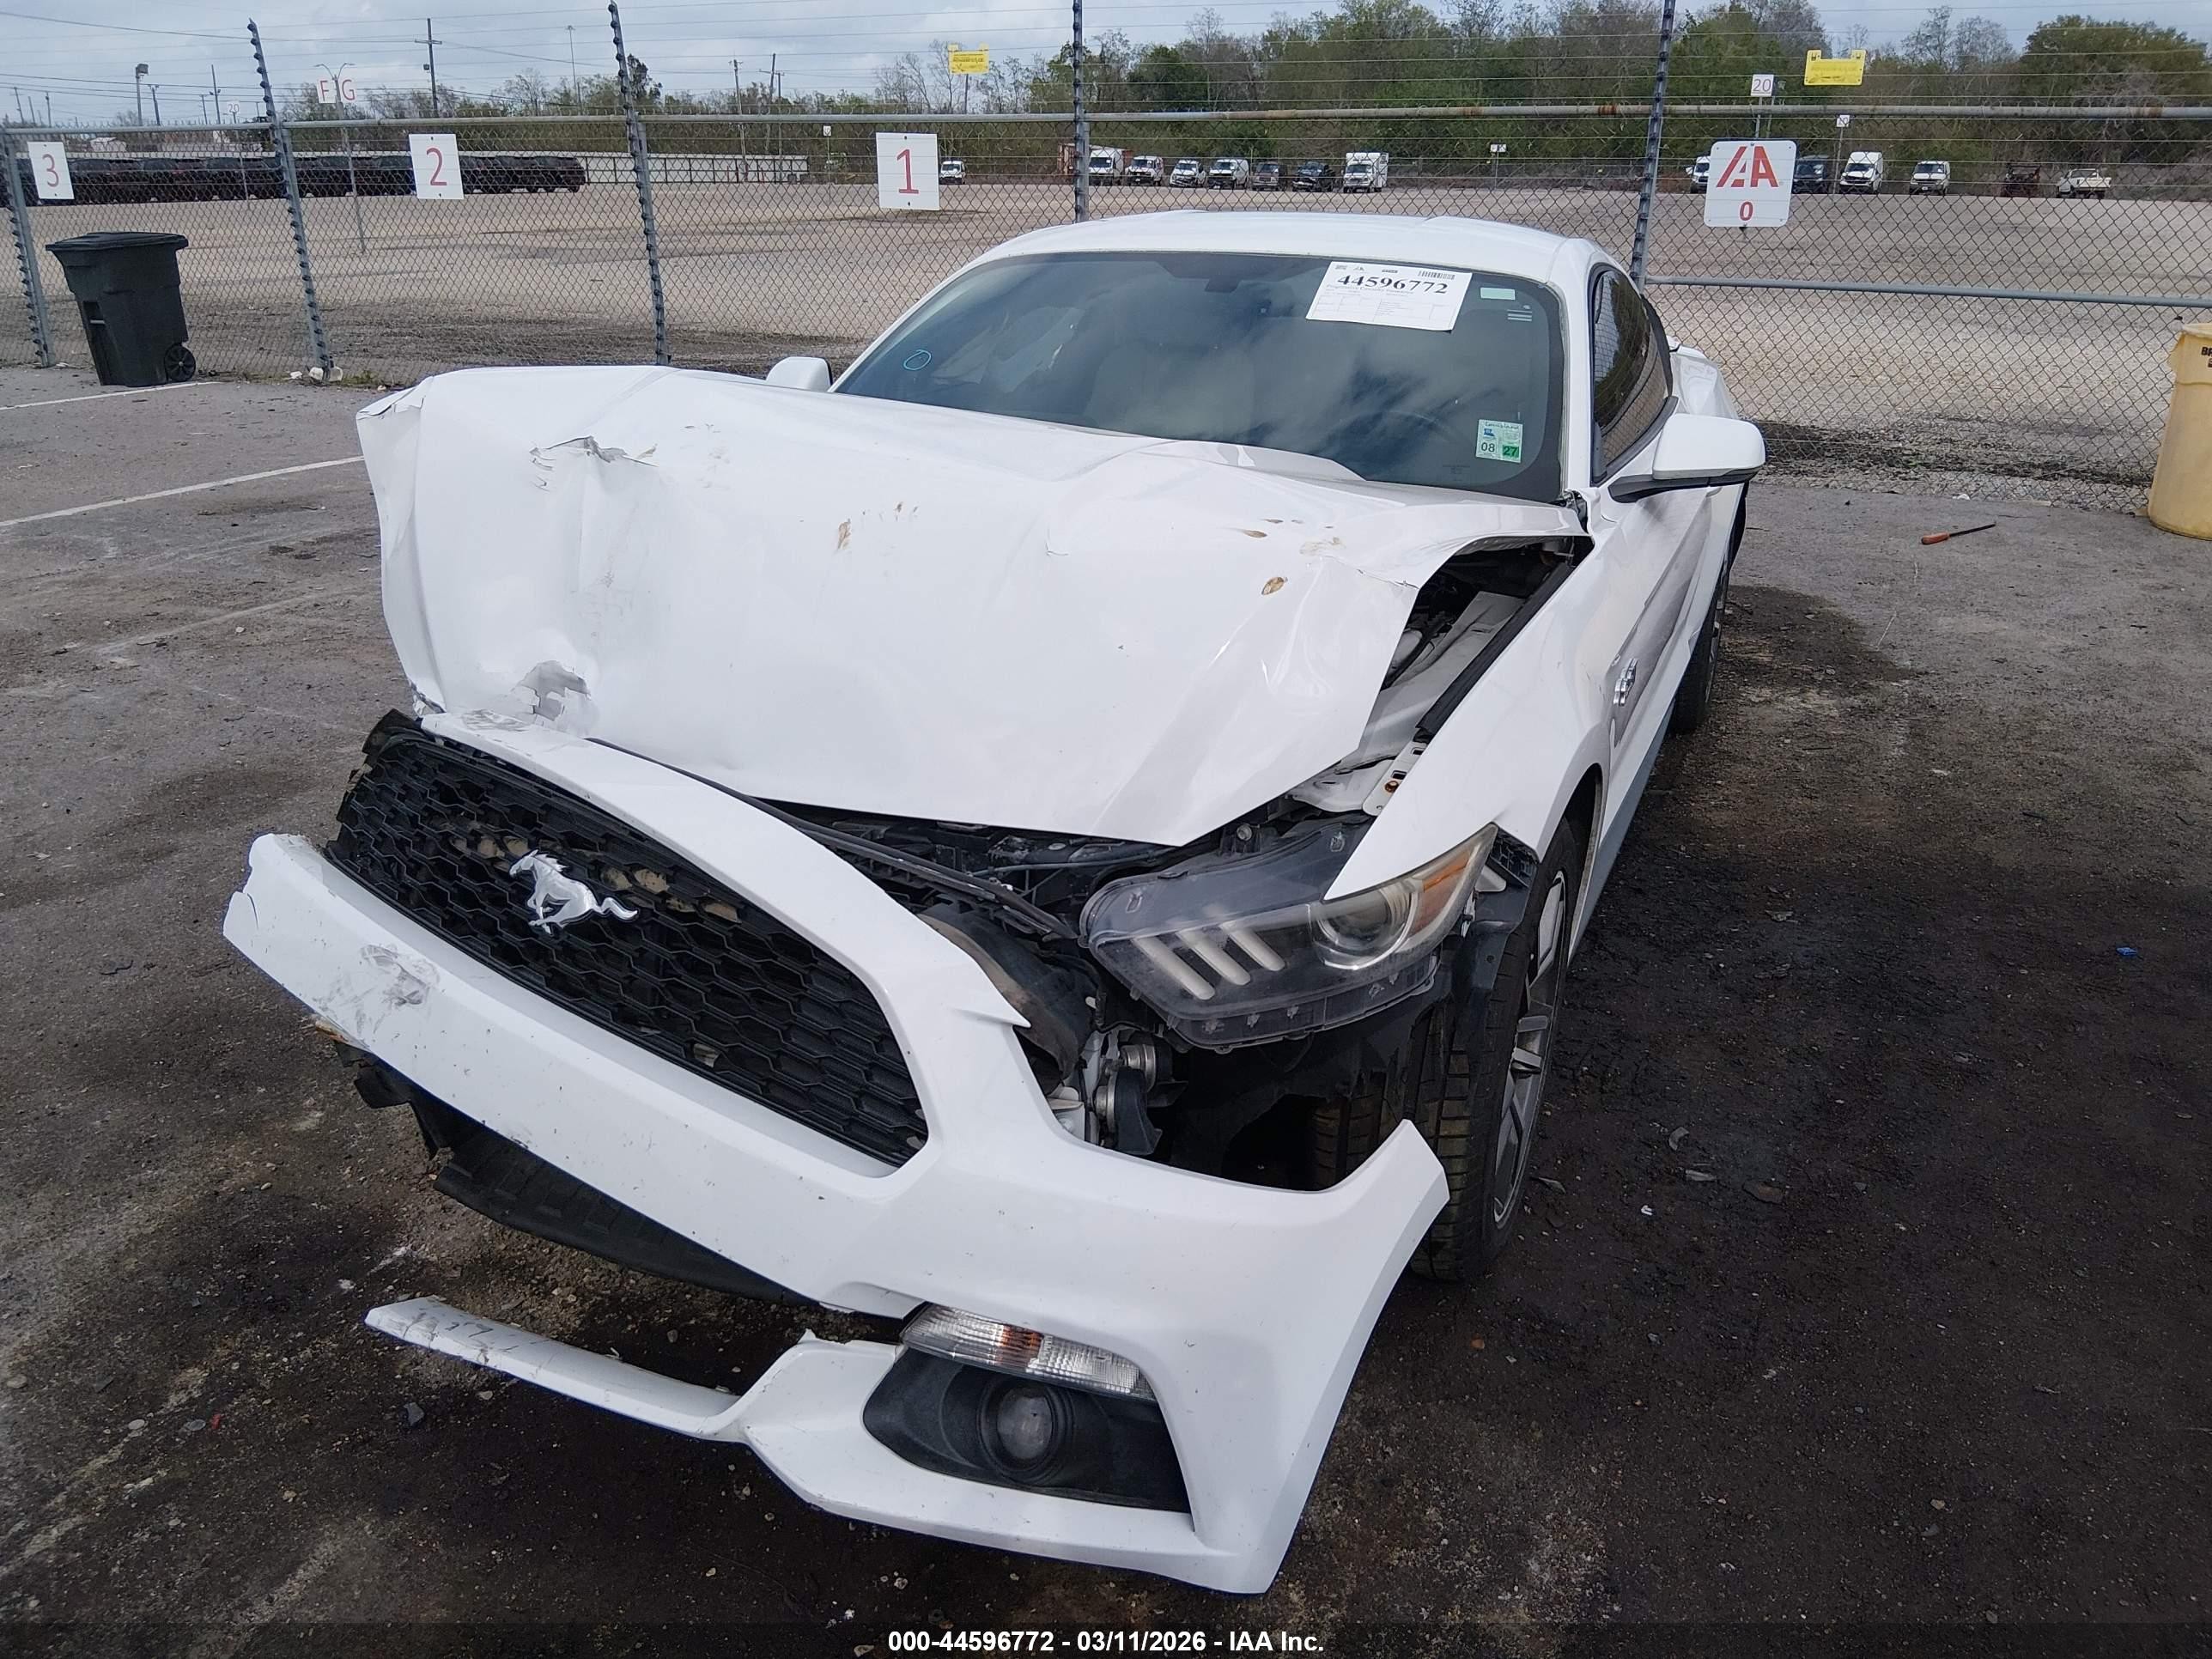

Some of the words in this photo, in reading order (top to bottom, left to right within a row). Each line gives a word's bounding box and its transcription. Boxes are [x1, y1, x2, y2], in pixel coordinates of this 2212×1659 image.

[319, 80, 330, 101] F
[343, 79, 356, 101] G
[1753, 78, 1771, 92] 20
[228, 103, 240, 113] 20
[42, 154, 59, 187] 3
[426, 148, 447, 186] 2
[896, 149, 920, 195] 1
[1740, 201, 1753, 221] 0
[1337, 274, 1449, 295] 44596772
[1481, 442, 1495, 453] 08
[1504, 446, 1517, 457] 27
